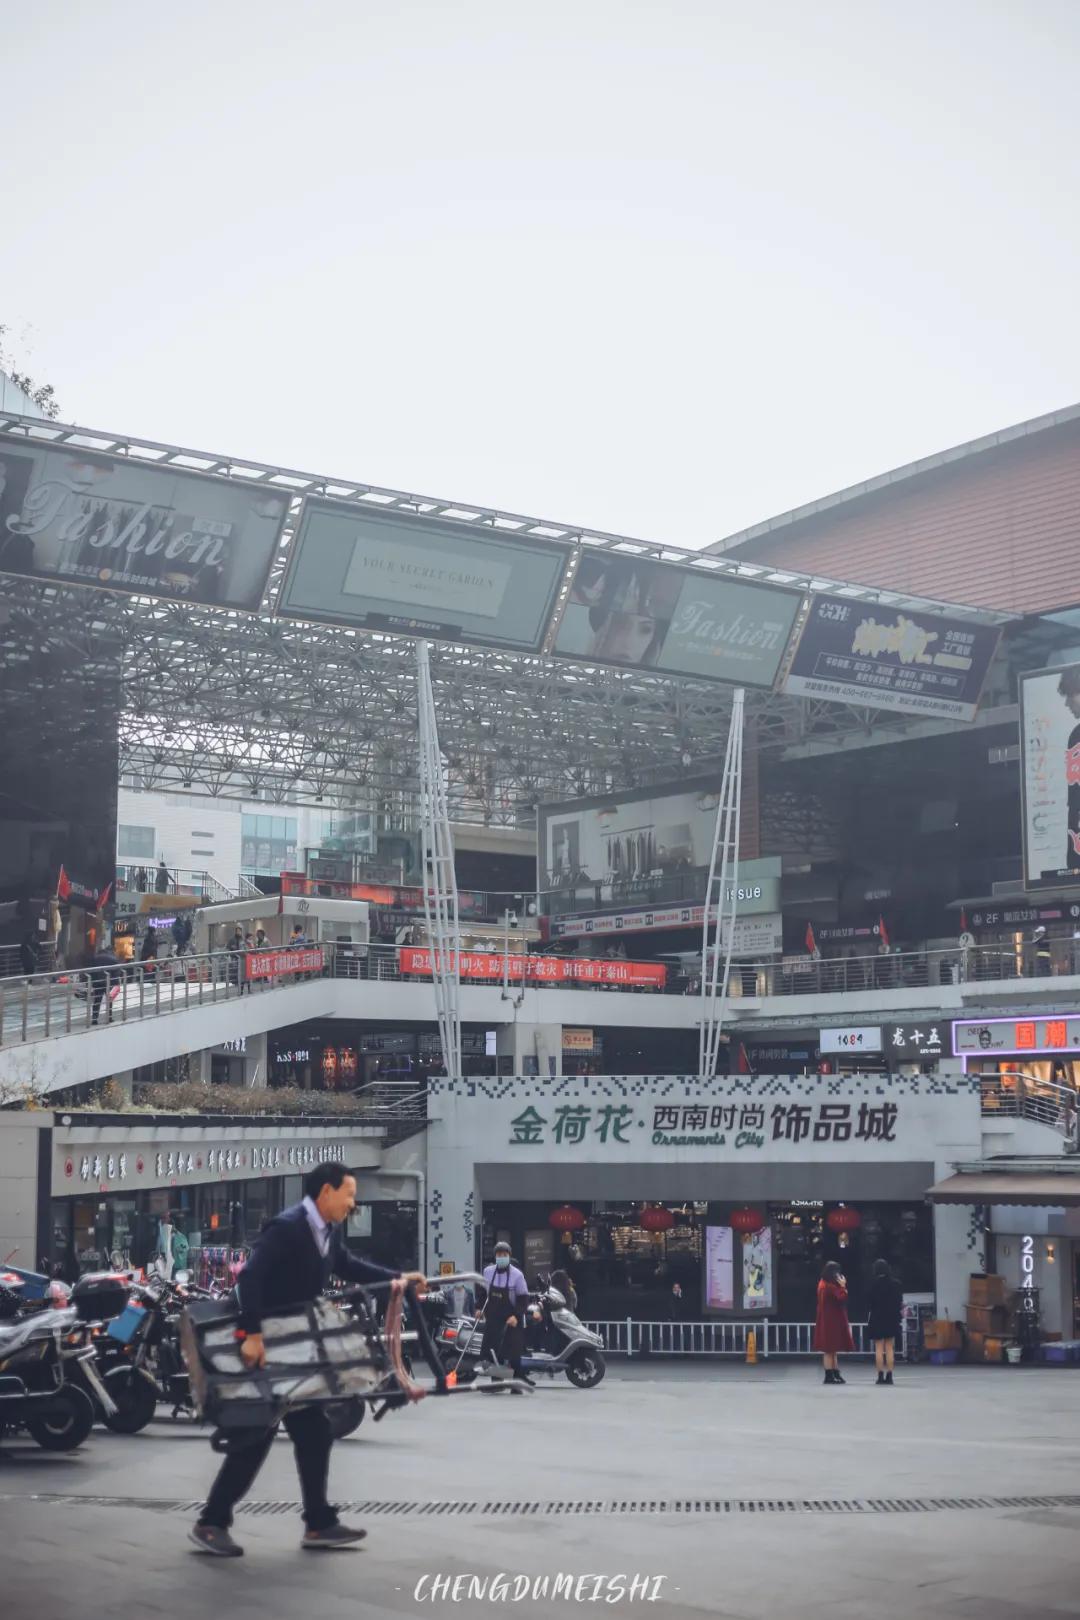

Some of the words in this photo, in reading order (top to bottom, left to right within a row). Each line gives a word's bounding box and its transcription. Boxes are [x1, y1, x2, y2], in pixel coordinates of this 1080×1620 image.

[6, 479, 226, 566] Fashion
[363, 557, 394, 572] YOUR
[400, 561, 446, 580] SECRET
[449, 573, 494, 590] GARDEN
[671, 601, 779, 650] Fashion
[726, 887, 761, 901] issue
[986, 912, 999, 924] 2F
[563, 961, 628, 980] 责任重于泰山
[891, 1027, 942, 1047] 龙十五
[1015, 1020, 1067, 1049] 国潮
[652, 1103, 765, 1131] 西南时尚
[770, 1102, 898, 1143] 饰品城
[652, 1131, 726, 1147] Ornaments
[735, 1131, 765, 1148] City
